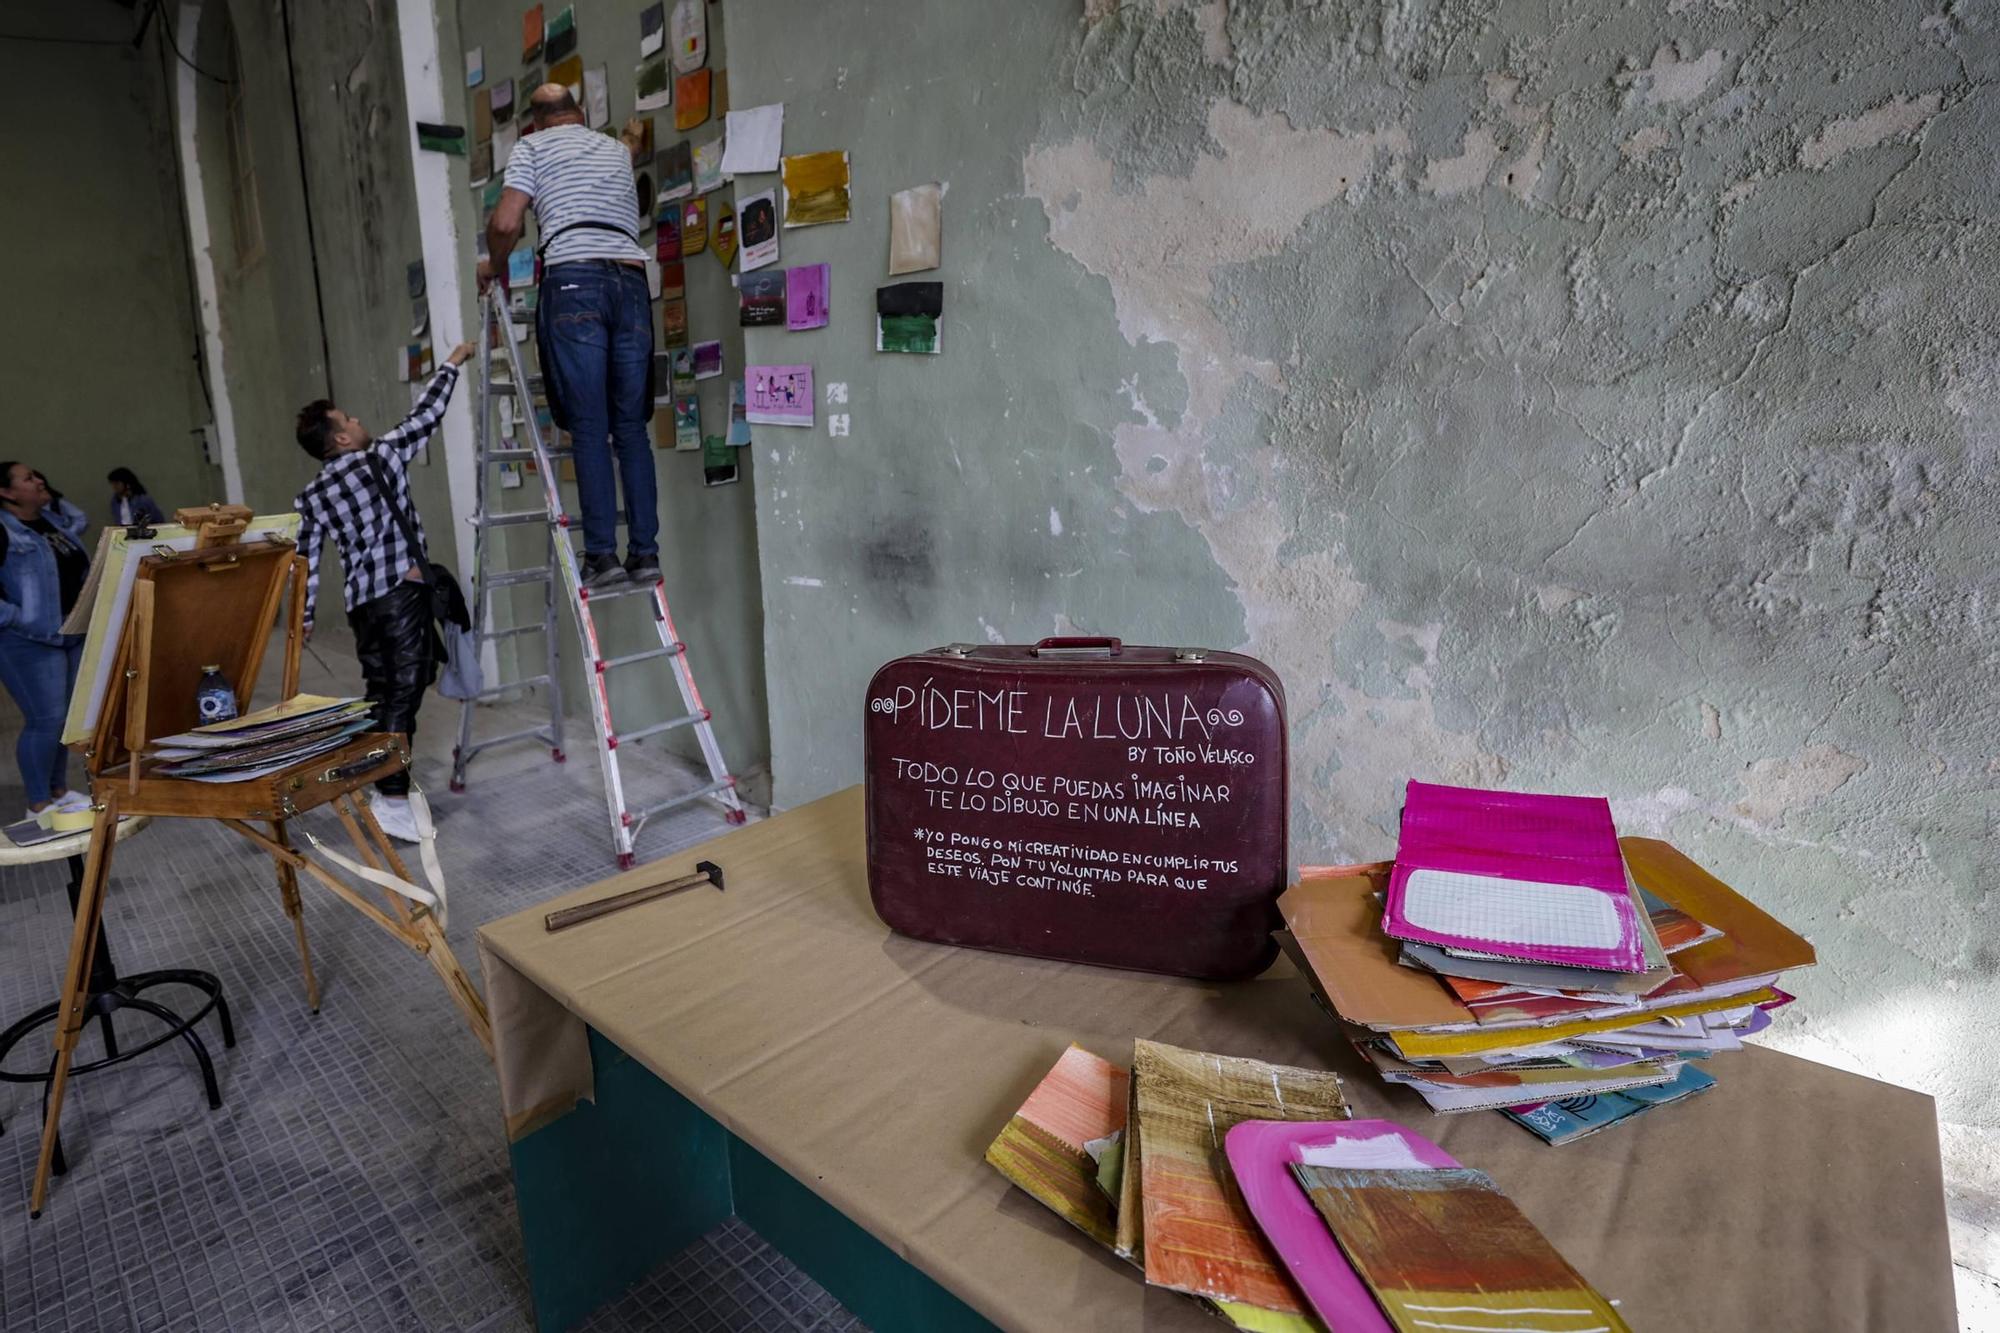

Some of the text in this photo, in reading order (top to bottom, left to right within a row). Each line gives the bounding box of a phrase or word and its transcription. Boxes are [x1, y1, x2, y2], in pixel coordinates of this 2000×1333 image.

[893, 677, 1210, 740] PÍDEME LA LUNA
[1128, 746, 1147, 763] BY
[891, 757, 958, 785] TODO
[965, 767, 995, 789] LO
[1002, 773, 1047, 793] QUE
[1053, 776, 1125, 800] PUEDAS
[924, 789, 954, 809] TE
[960, 791, 986, 811] LO
[1068, 802, 1099, 823] EN
[1103, 805, 1140, 825] UNA
[1144, 802, 1201, 829] LÍNEA
[927, 862, 962, 877] ESTE
[951, 832, 1003, 850] PONGO
[1211, 860, 1239, 873] TUS
[990, 853, 1021, 869] PON
[1025, 859, 1046, 871] TU
[1050, 860, 1122, 882] VOLUNTAD
[1127, 869, 1169, 887] PARA
[1174, 877, 1208, 890] QUE
